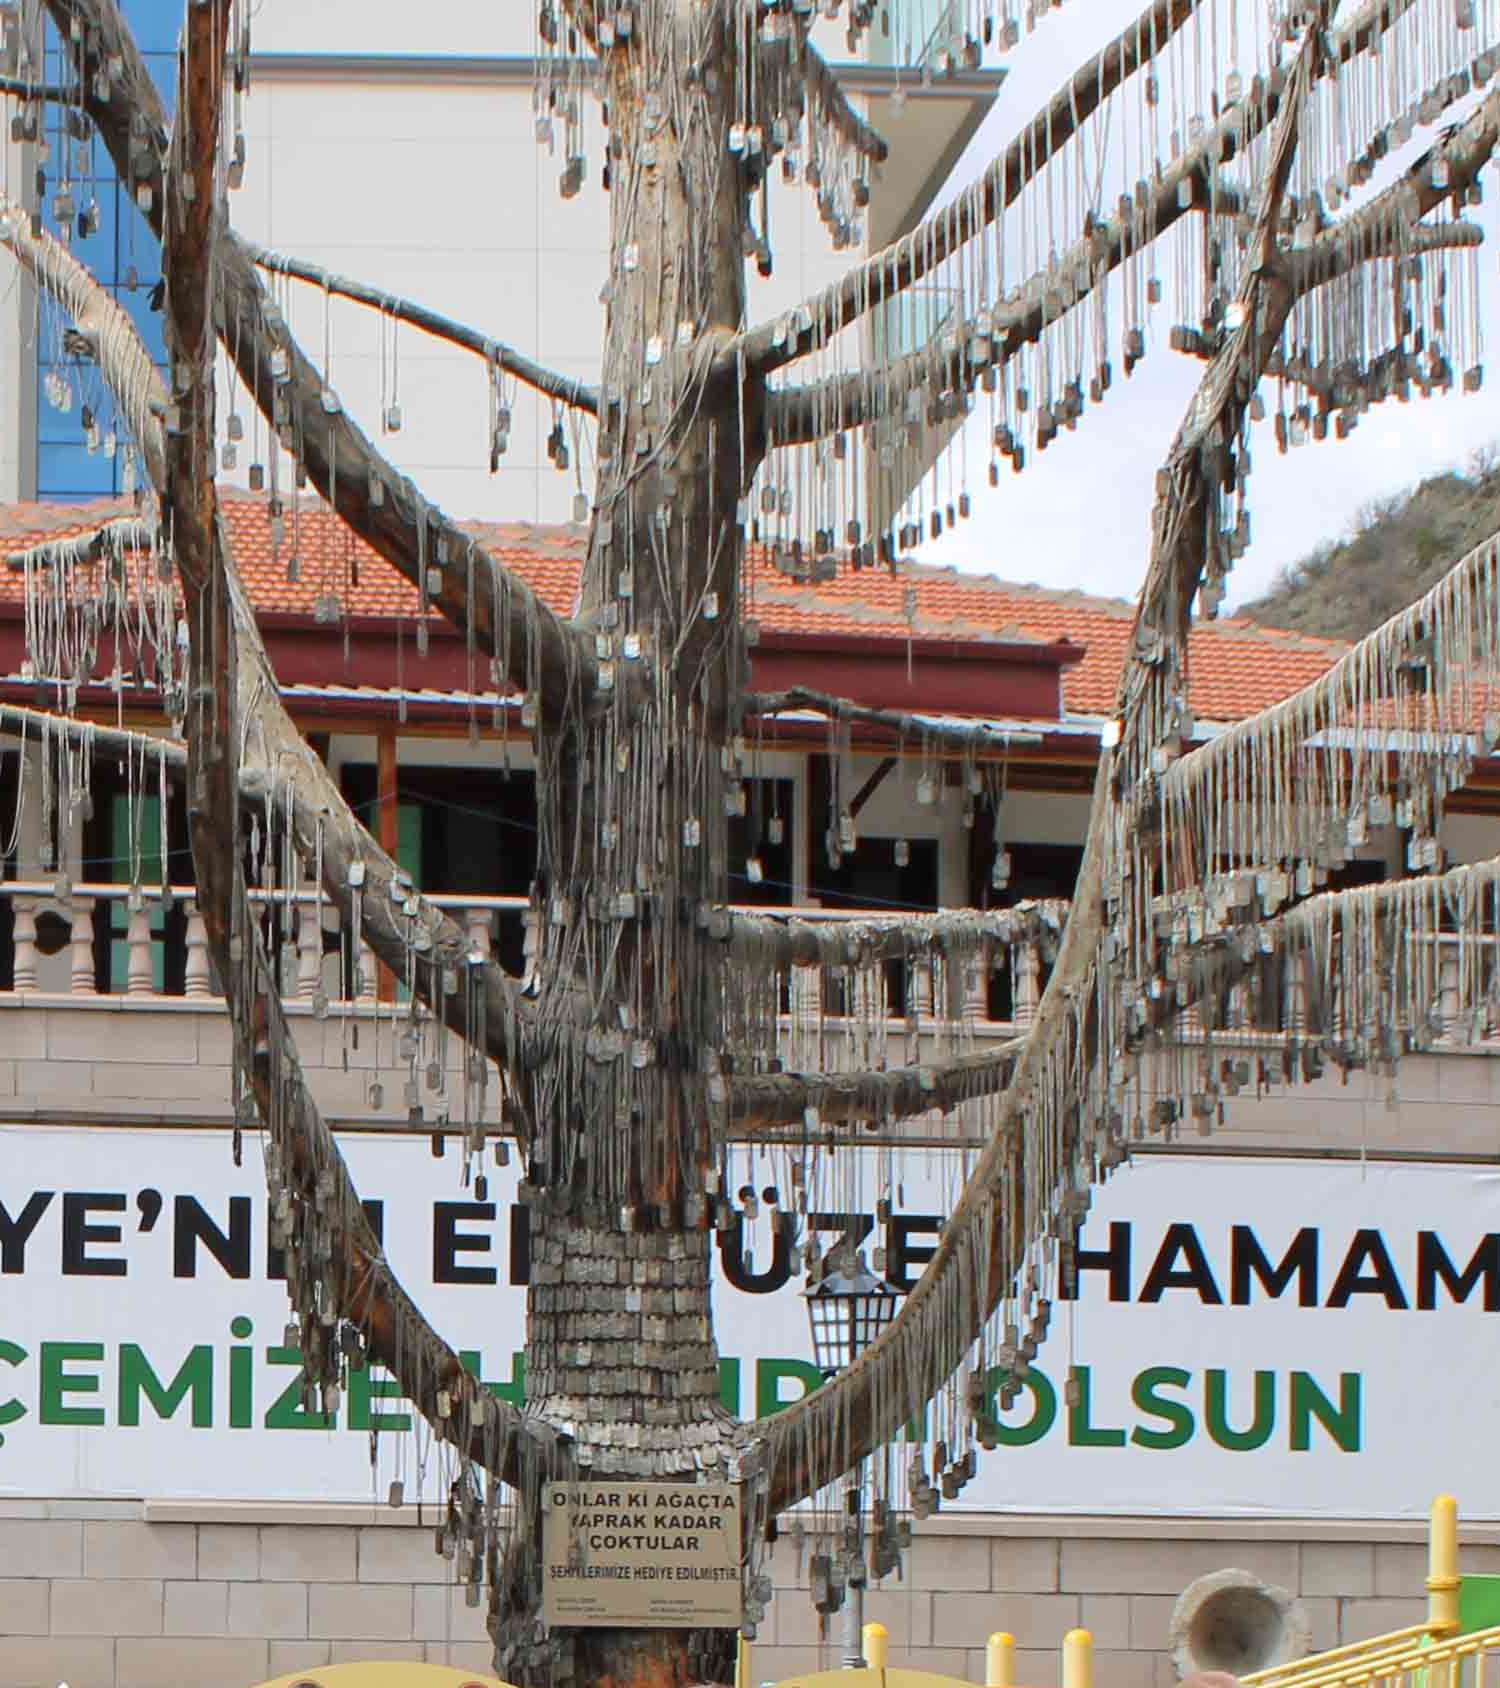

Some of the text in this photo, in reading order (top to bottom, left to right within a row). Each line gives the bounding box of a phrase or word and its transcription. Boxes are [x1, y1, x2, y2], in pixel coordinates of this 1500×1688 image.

[433, 1201, 530, 1286] E
[978, 1363, 1363, 1453] OLSUN
[553, 1492, 621, 1508] ONLAR
[655, 1491, 736, 1513] AĞAÇTA
[653, 1515, 722, 1530] KADAR
[589, 1534, 700, 1553] ÇOKTULAR
[633, 1565, 673, 1581] HEDİYE
